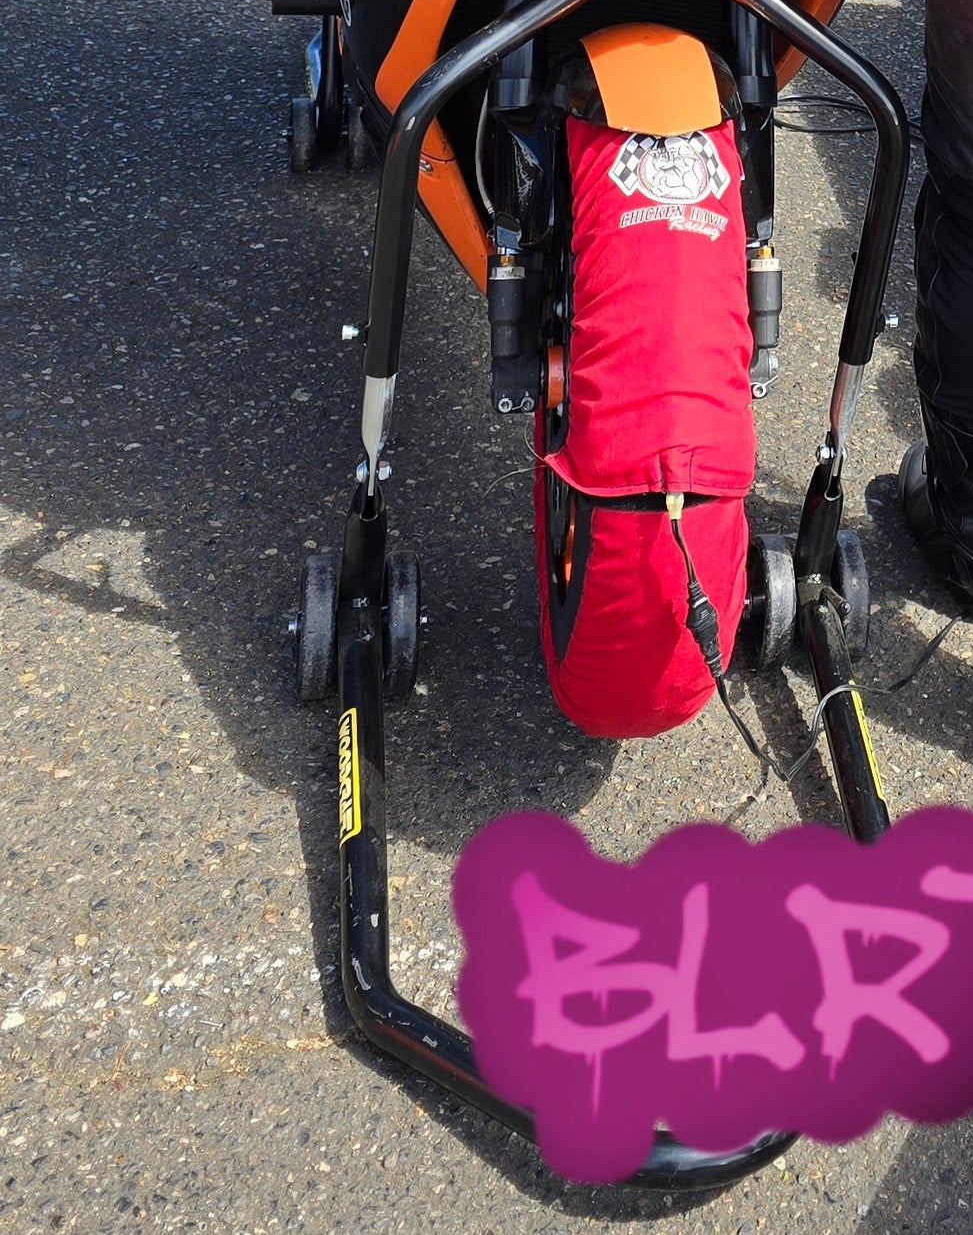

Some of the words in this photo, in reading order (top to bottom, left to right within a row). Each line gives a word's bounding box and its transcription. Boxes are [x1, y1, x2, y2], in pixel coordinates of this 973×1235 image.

[620, 205, 685, 228] CHICKEN
[690, 206, 729, 232] HAWK
[669, 218, 721, 242] Racing
